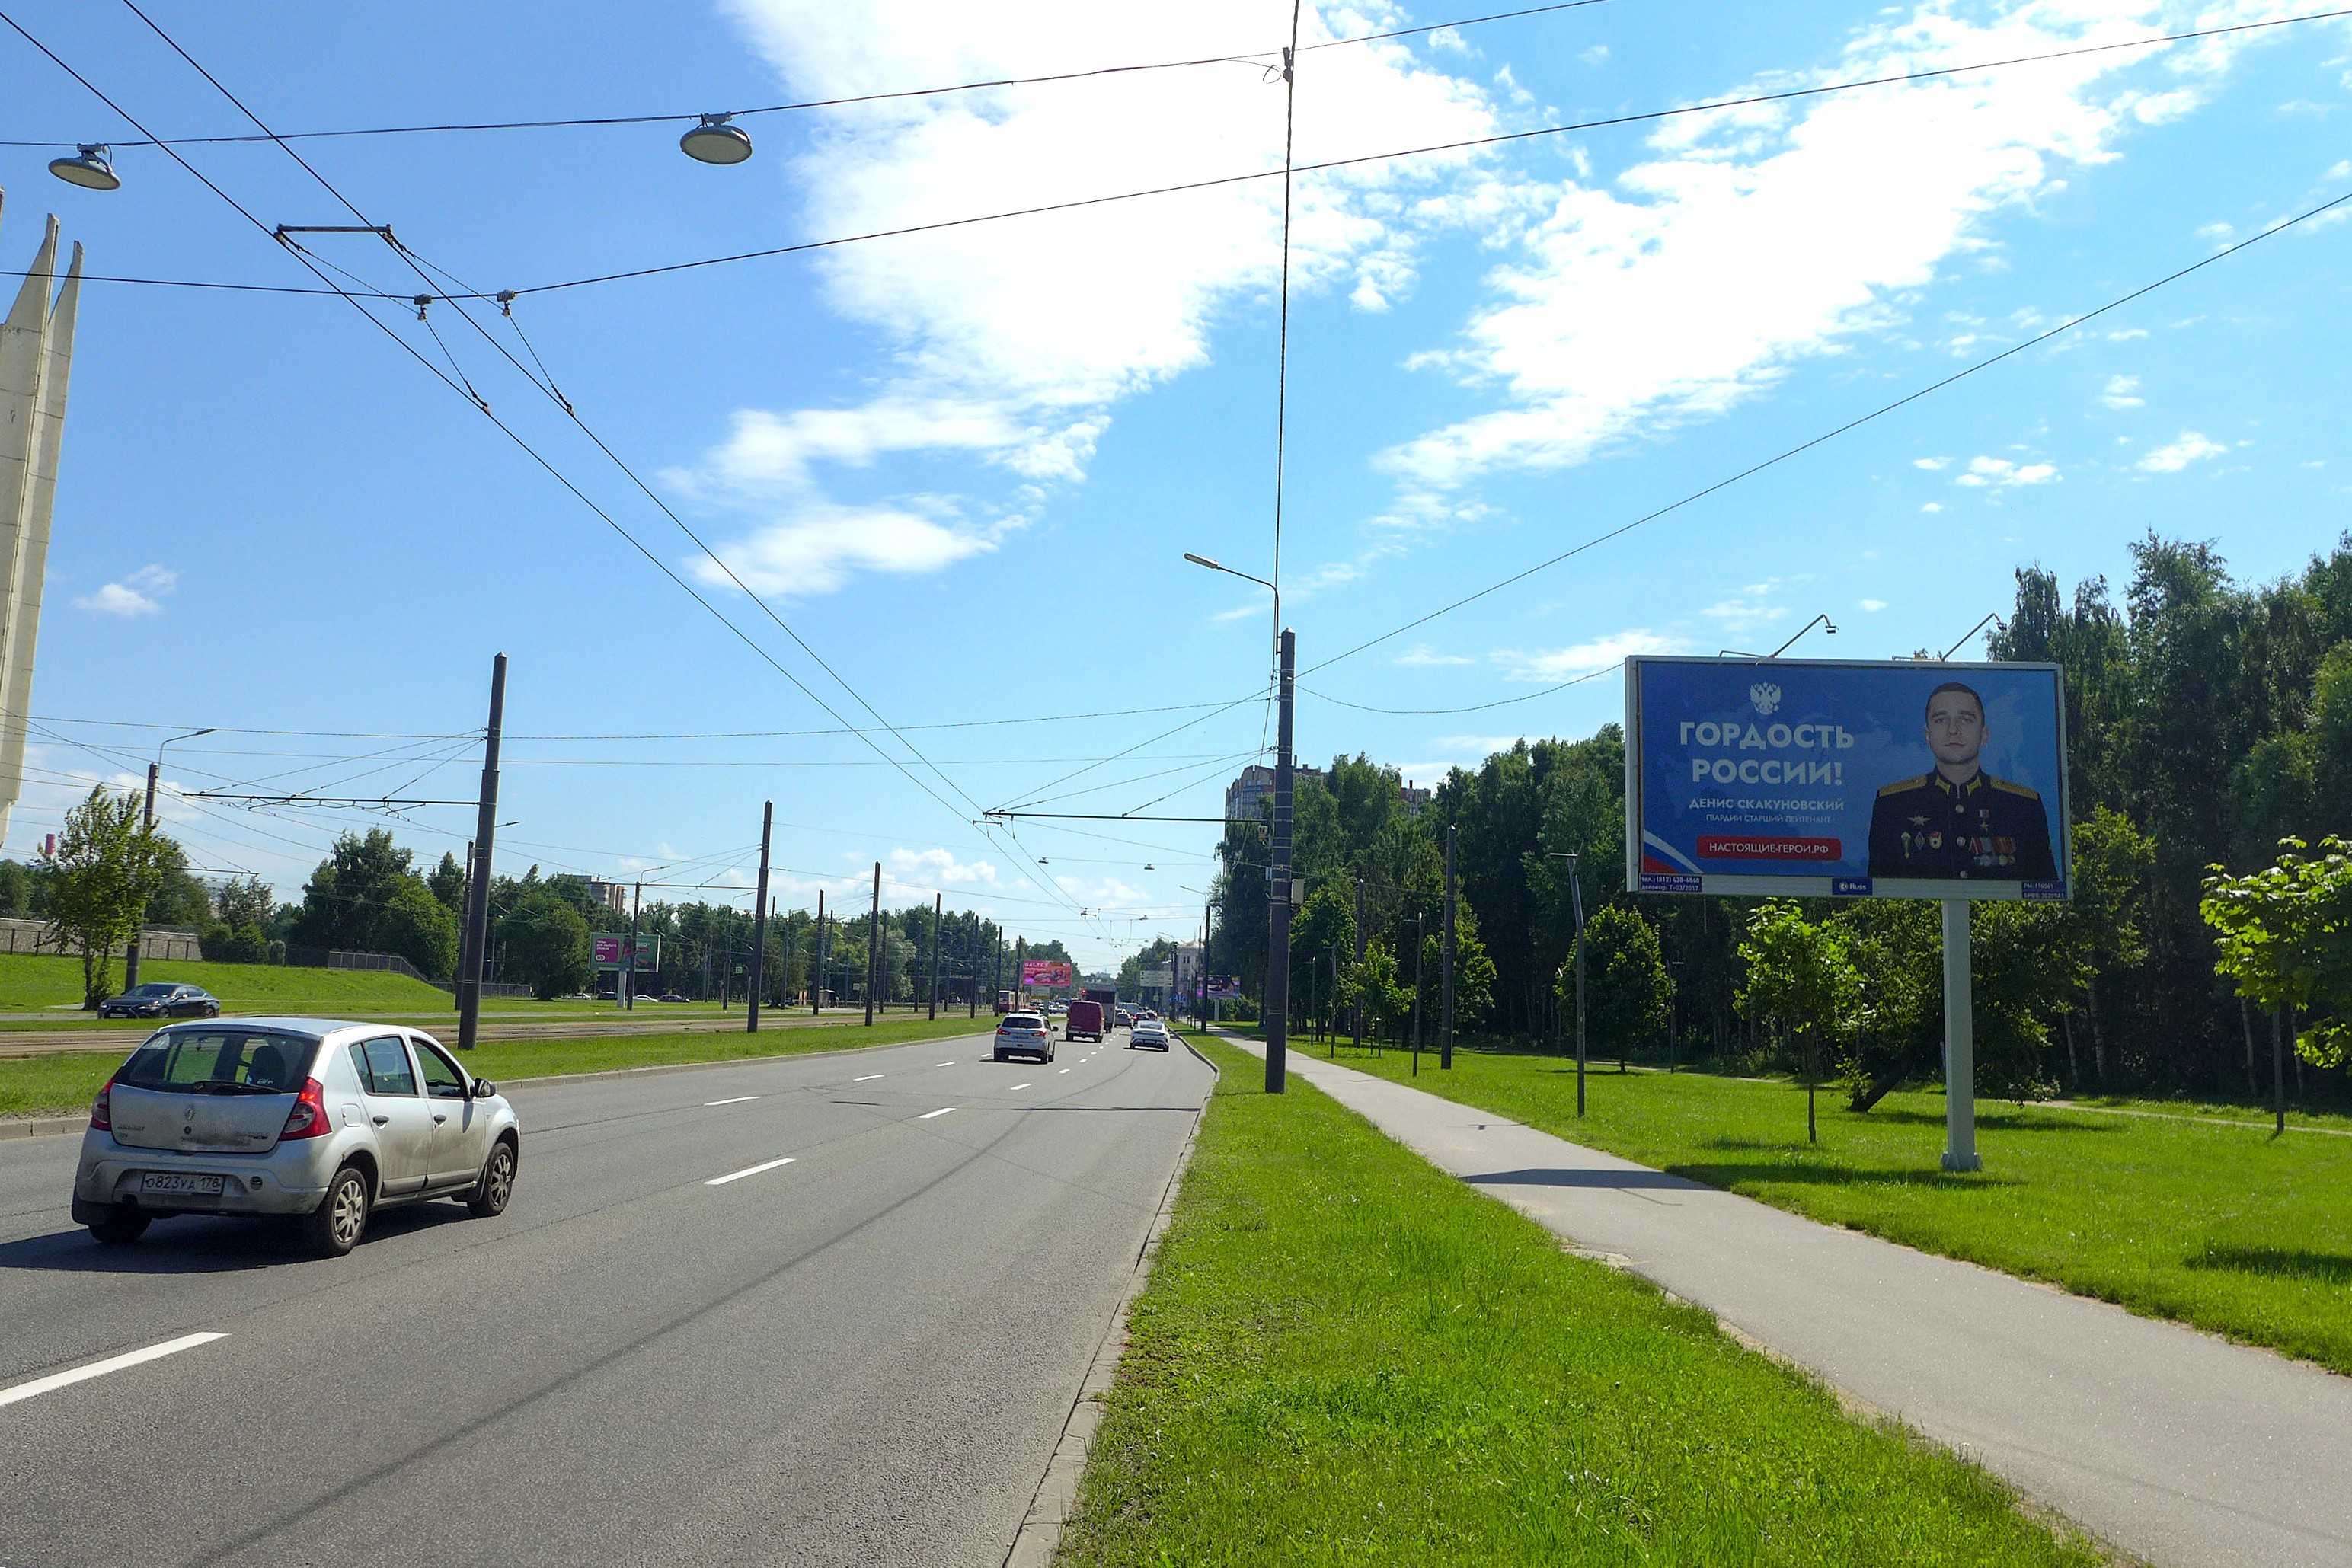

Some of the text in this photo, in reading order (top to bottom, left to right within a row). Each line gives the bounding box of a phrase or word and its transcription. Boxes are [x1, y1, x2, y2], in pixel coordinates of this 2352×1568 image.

[1679, 721, 1855, 750] ГОРДОСТЬ
[1692, 758, 1842, 786] РОССИИ!
[1689, 798, 1845, 812] ДЕНИС СКАКУНОВСКИЙ
[1705, 814, 1743, 822] ГВАРДИИ
[1744, 814, 1784, 823] СТАРШИЙ
[1709, 842, 1830, 855] НАСТОЯЩИЕ-ГЕРОИ.РФ
